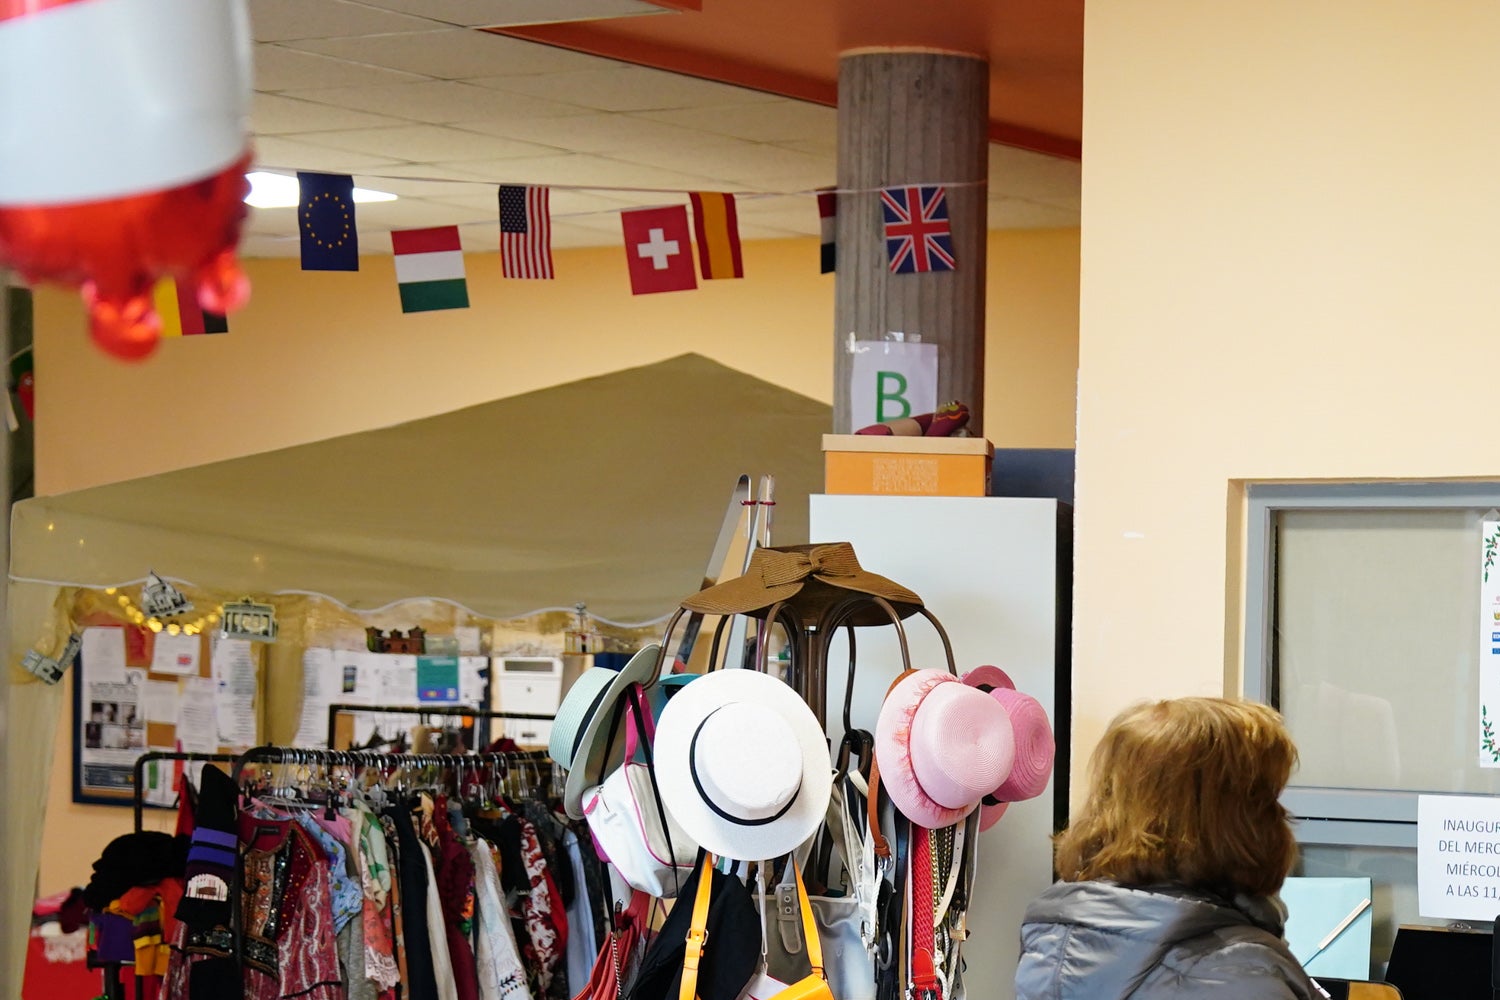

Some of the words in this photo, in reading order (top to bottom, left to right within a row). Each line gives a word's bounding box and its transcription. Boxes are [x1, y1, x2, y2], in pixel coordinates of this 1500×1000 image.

[876, 371, 911, 423] B
[1439, 840, 1460, 853] DEL
[1446, 884, 1454, 896] A
[1458, 886, 1479, 898] LAS
